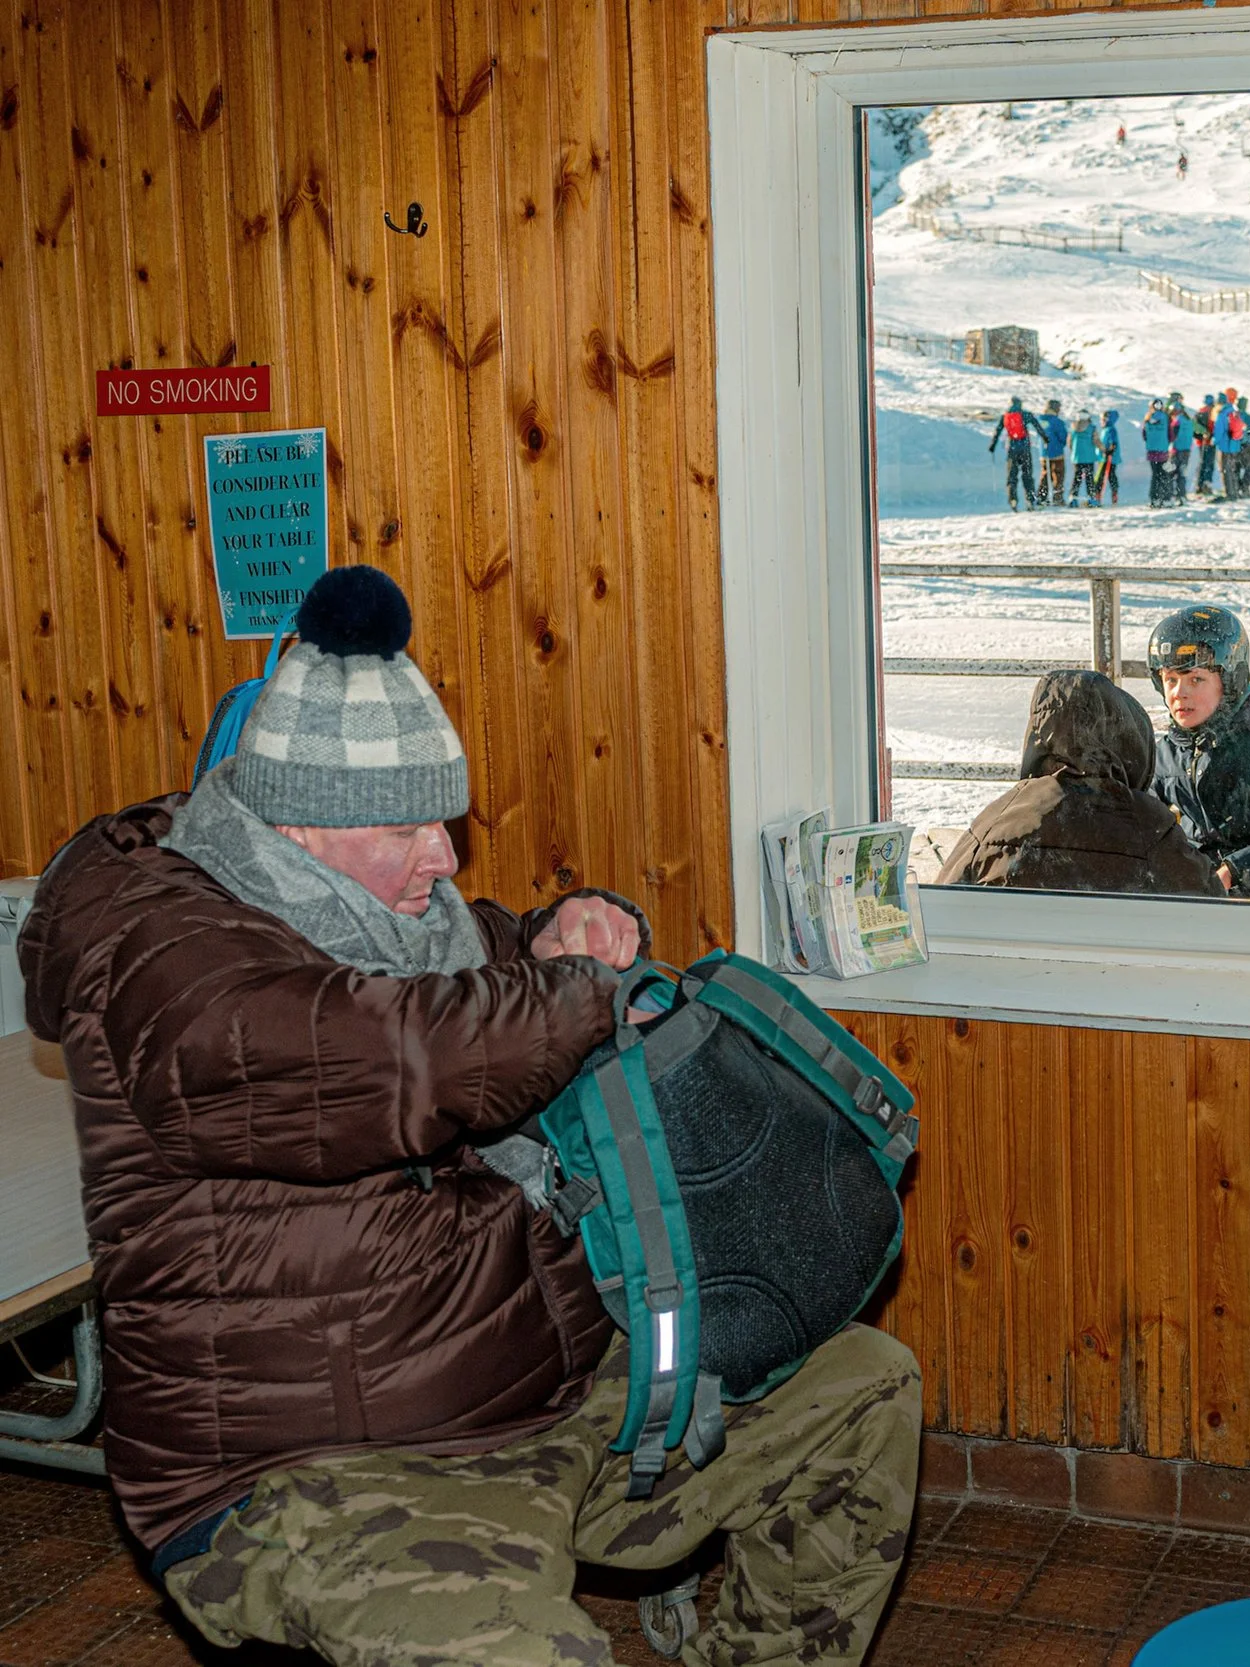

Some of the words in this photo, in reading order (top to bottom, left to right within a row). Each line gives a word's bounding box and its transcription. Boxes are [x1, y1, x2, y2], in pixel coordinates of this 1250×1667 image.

[108, 380, 140, 405] NO
[149, 376, 258, 404] SMOKING
[225, 447, 282, 465] PLEASE
[286, 444, 306, 461] BE
[212, 473, 321, 495] CONSIDERATE
[224, 505, 256, 522] AND
[260, 502, 310, 520] CLEAR
[222, 534, 264, 550] YOUR
[266, 530, 316, 548] TABLE
[246, 560, 292, 577] WHEN
[239, 589, 305, 606] FINISHED
[249, 615, 279, 626] THANK
